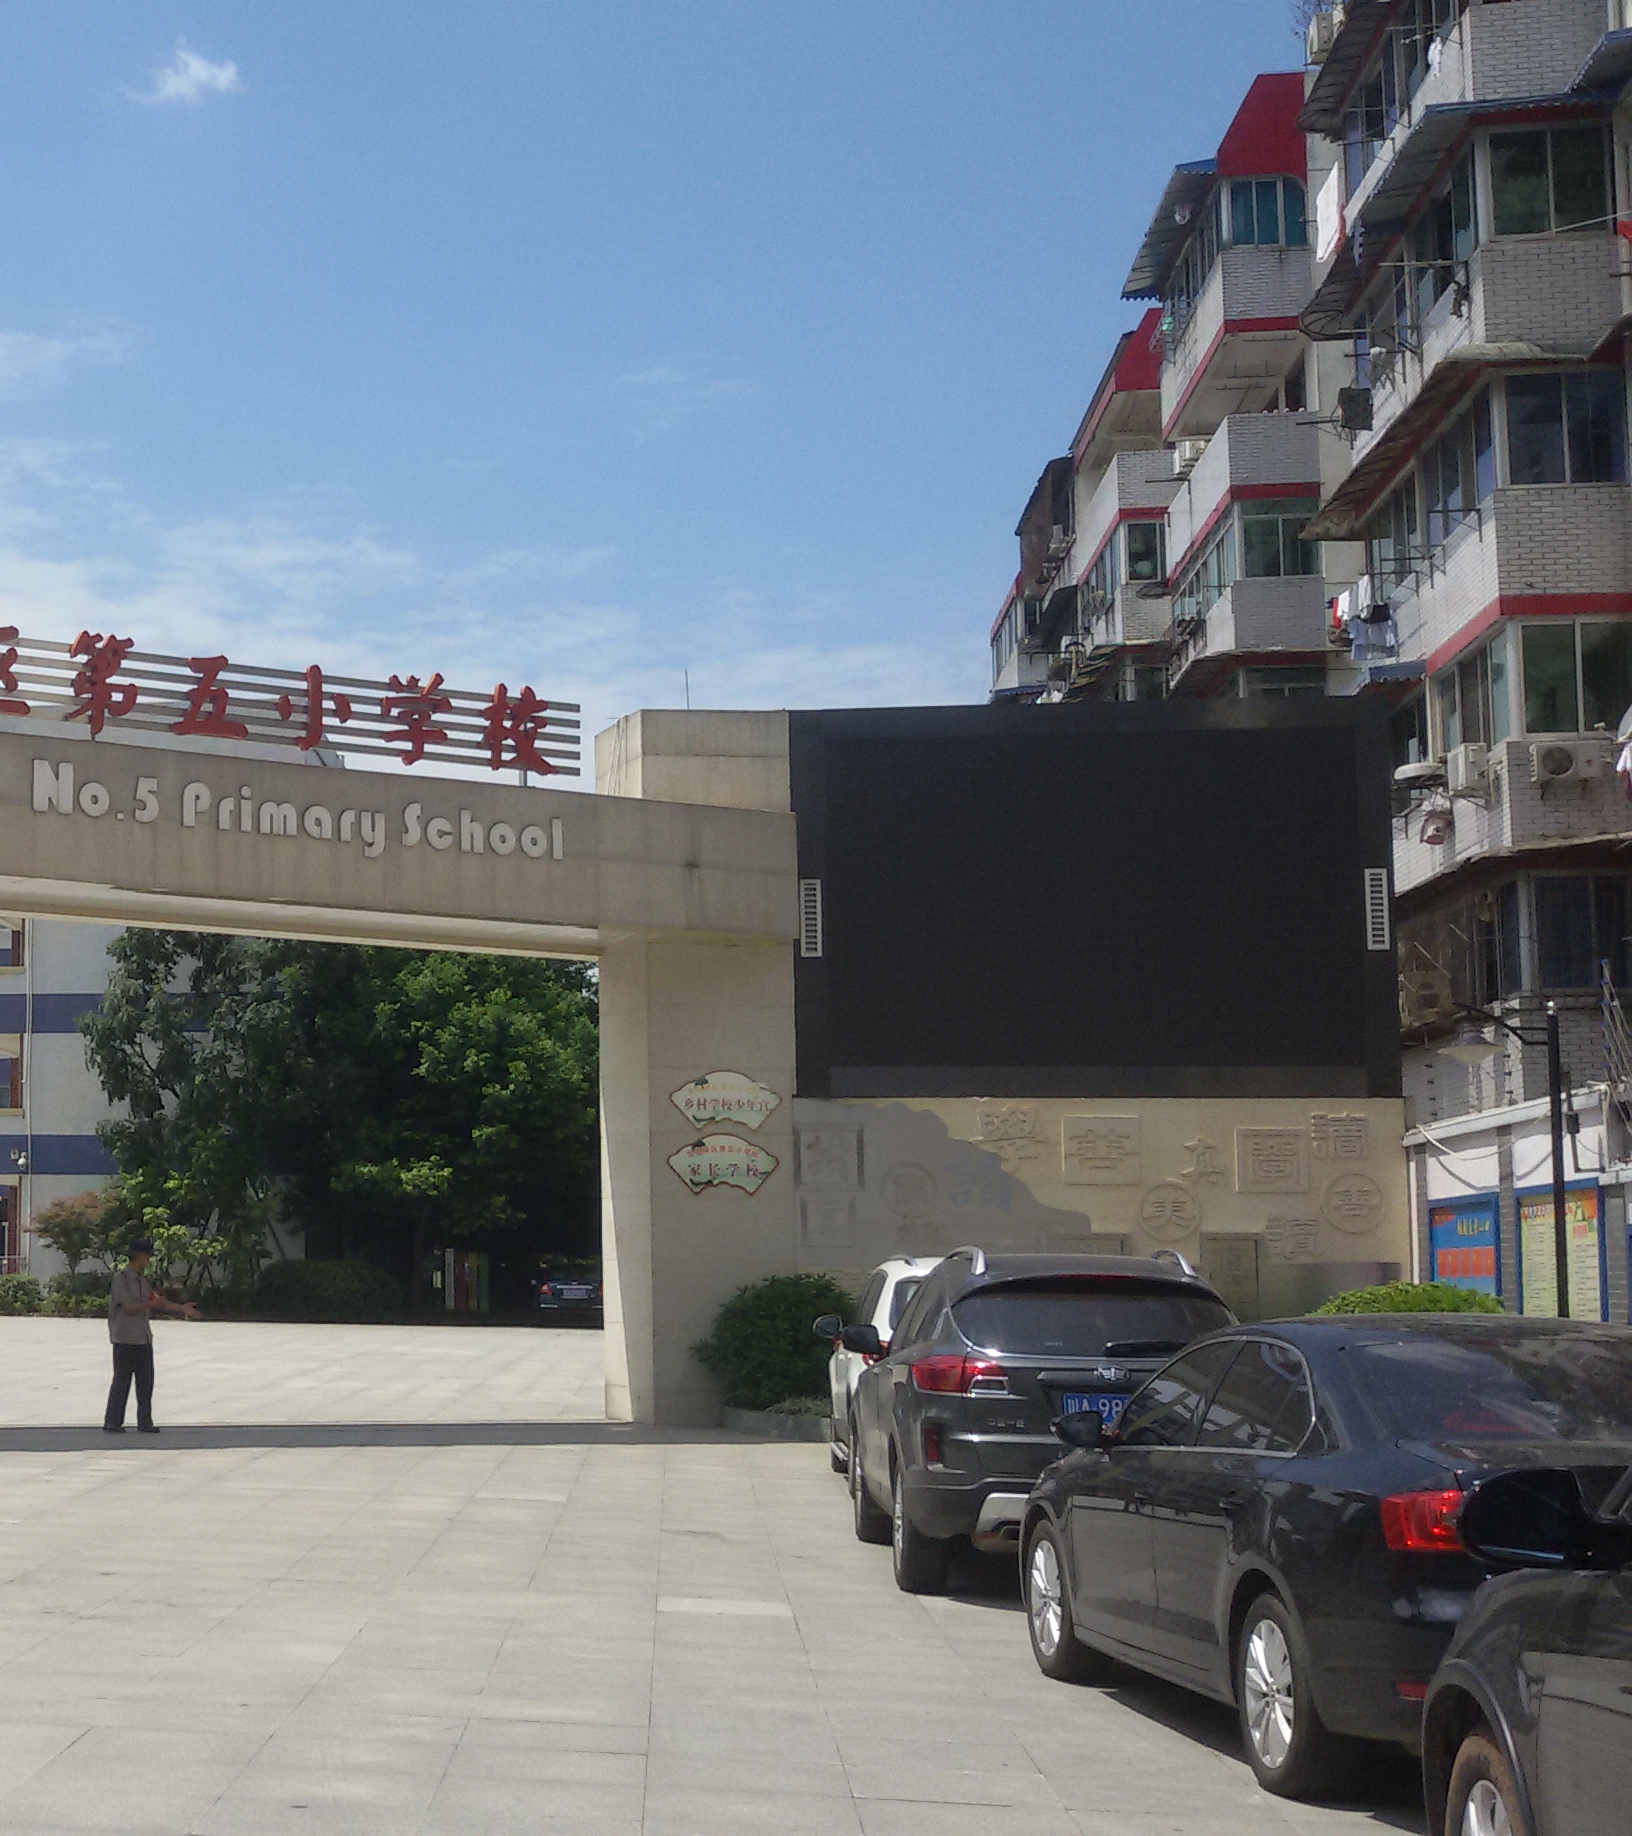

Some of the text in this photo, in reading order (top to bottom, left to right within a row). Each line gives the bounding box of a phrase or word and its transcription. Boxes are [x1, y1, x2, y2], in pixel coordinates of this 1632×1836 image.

[181, 780, 386, 858] Primary
[402, 802, 564, 861] School
[687, 1162, 759, 1178] 家长学校
